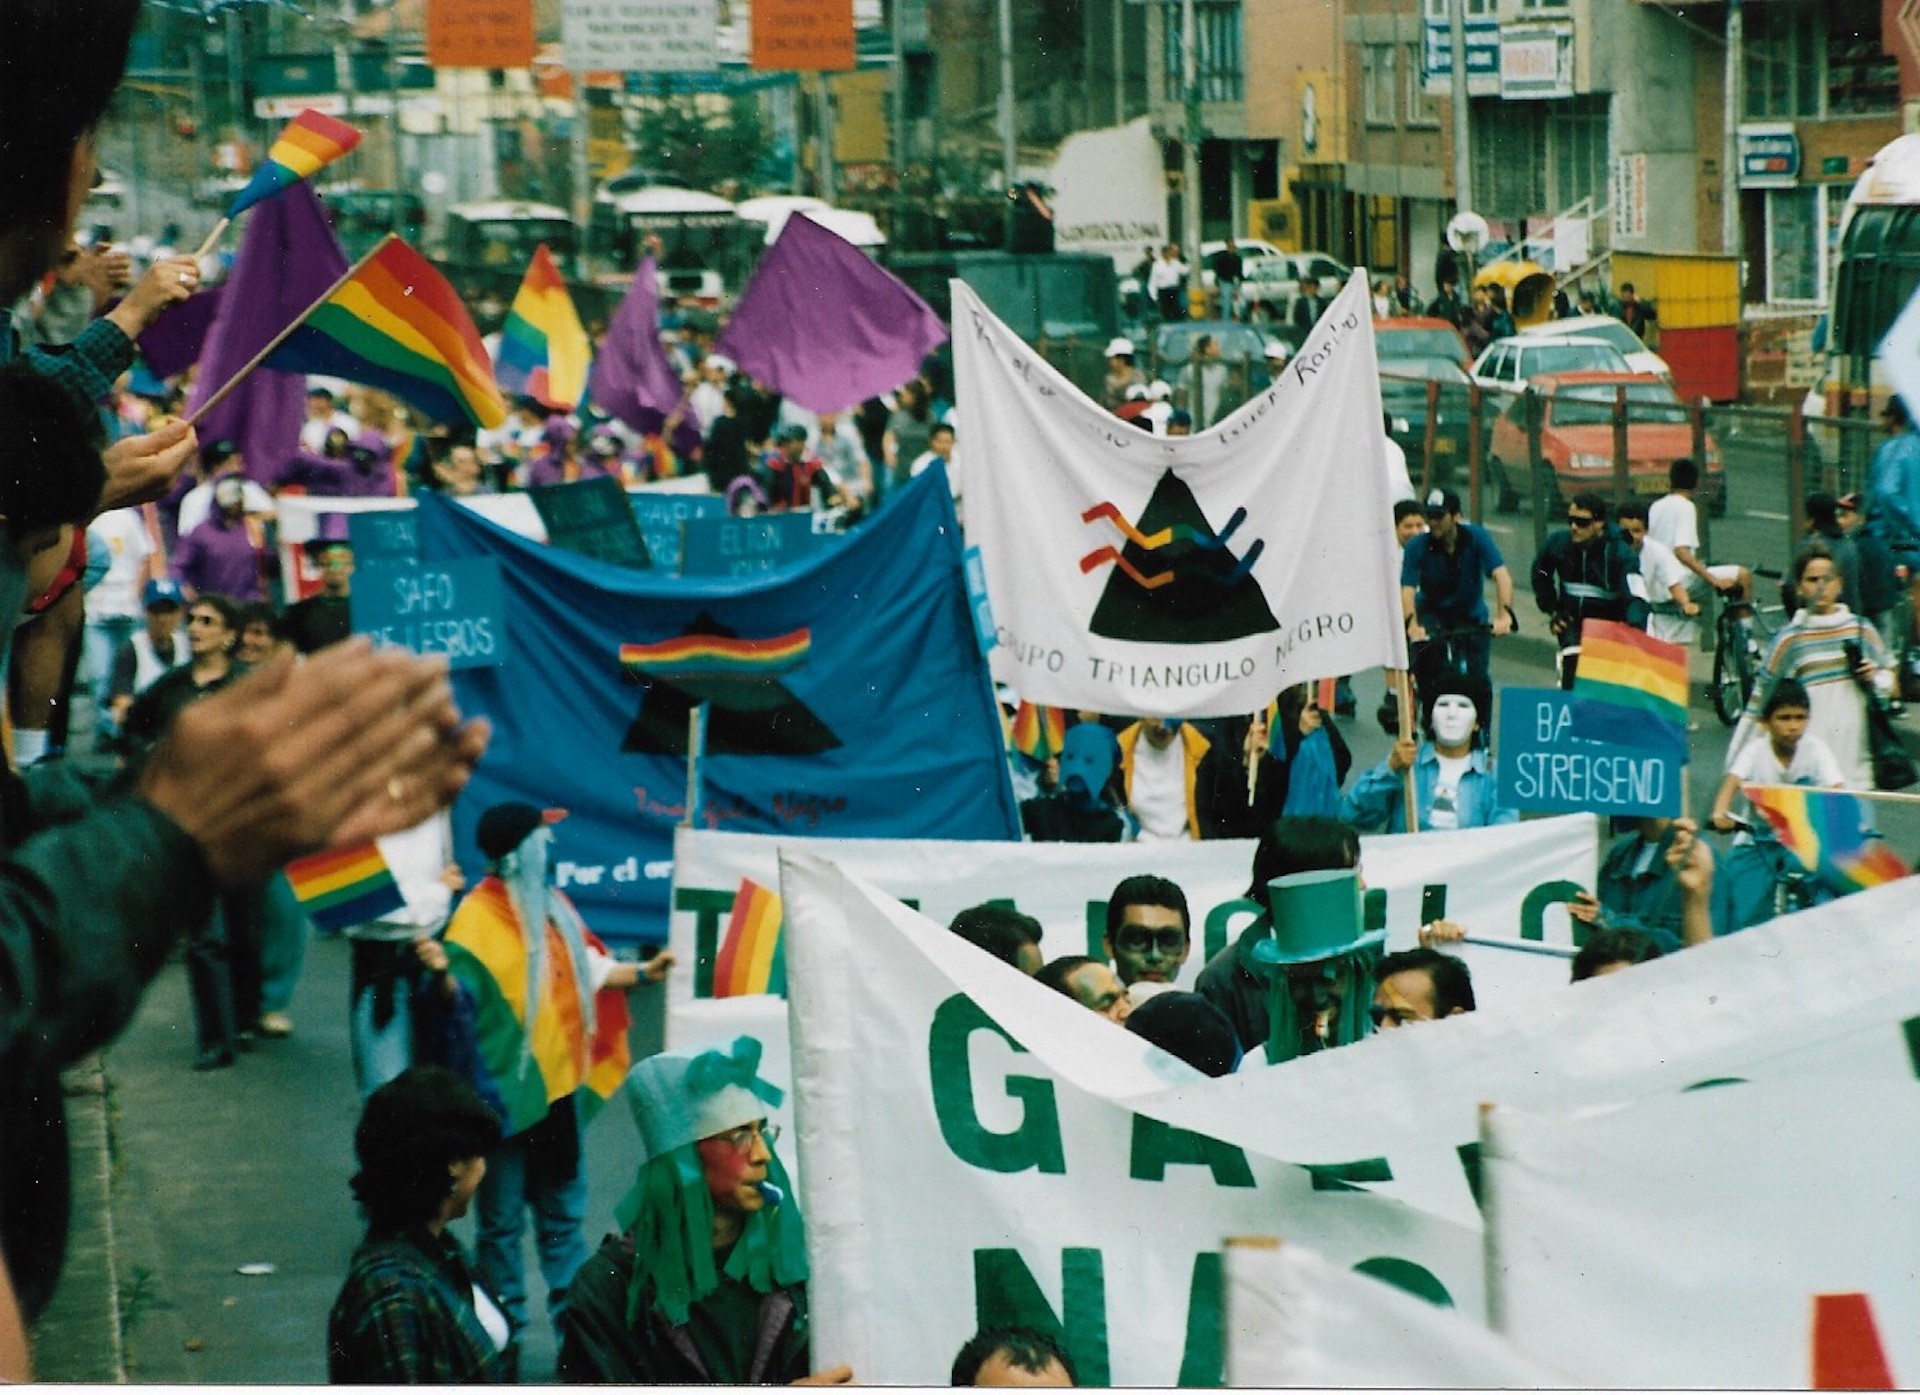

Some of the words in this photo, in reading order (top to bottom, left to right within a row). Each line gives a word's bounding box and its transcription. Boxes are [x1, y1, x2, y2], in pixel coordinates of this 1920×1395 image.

[393, 572, 455, 615] SAFO
[1088, 656, 1256, 688] TRIANGULO
[1275, 612, 1354, 666] NEGRO
[1515, 752, 1664, 805] STREISEND
